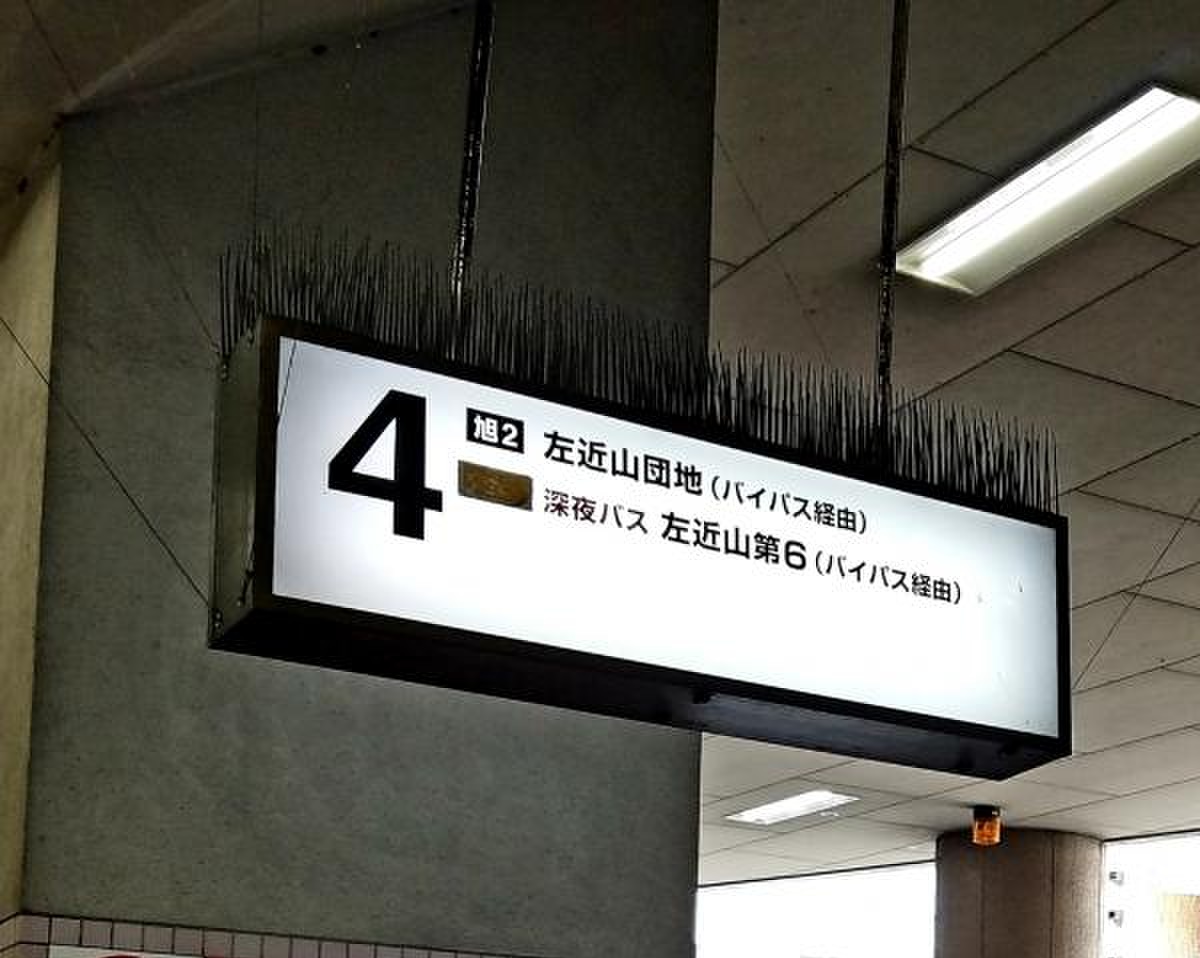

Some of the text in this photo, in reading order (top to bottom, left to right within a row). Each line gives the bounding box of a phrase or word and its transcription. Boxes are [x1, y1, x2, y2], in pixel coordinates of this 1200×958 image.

[472, 413, 521, 450] 旭2
[328, 389, 443, 541] 4
[543, 487, 650, 536] 深夜バス
